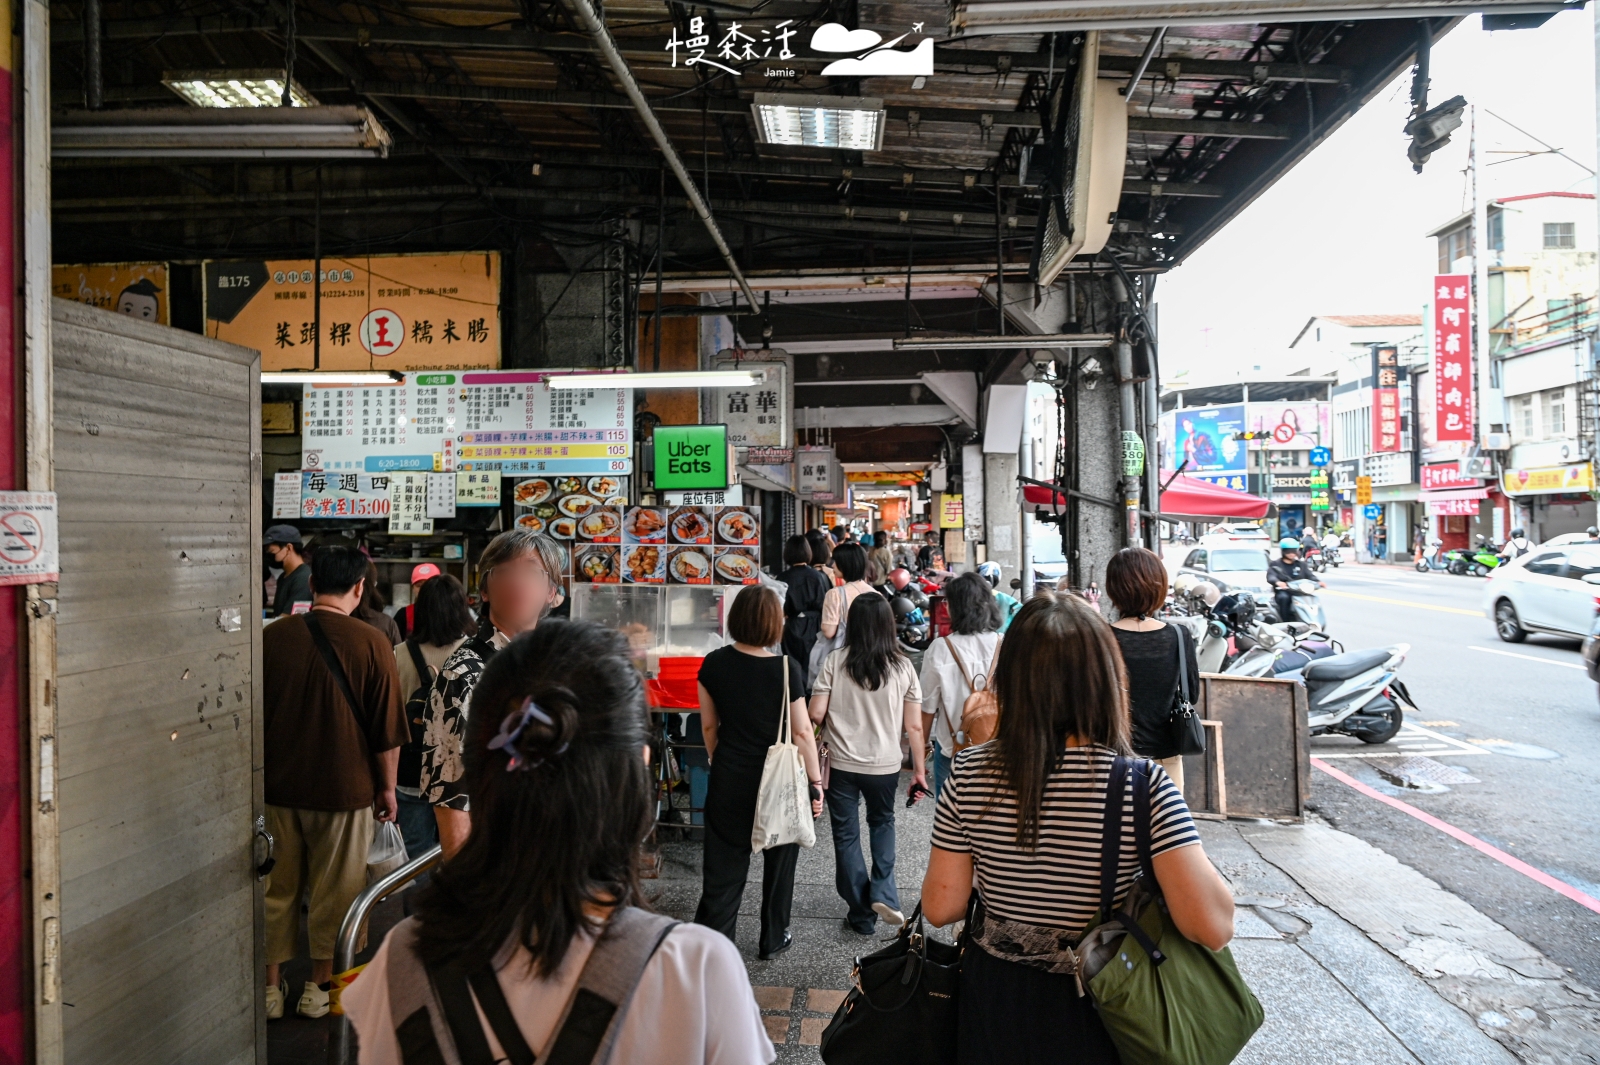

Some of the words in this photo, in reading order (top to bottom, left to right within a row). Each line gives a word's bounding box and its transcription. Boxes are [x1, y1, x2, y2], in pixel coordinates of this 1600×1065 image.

[372, 316, 394, 348] 王
[411, 317, 490, 345] 糯米腸
[405, 364, 444, 372] Taichung
[445, 363, 461, 371] 2nd
[463, 363, 491, 371] Market
[525, 385, 534, 393] 65
[526, 393, 534, 401] 80
[727, 391, 777, 413] 富華
[525, 400, 534, 408] 65
[616, 412, 625, 420] 65
[757, 415, 777, 425] 服裝
[607, 430, 625, 440] 115
[607, 446, 625, 455] 105
[668, 441, 711, 457] Uber
[1121, 451, 1144, 459] 580
[611, 461, 625, 470] 80
[668, 458, 712, 474] Eats
[802, 465, 826, 476] 富華
[308, 473, 388, 493] 每週四
[468, 474, 490, 483] 新品
[682, 492, 726, 506] 座位有限
[302, 498, 391, 516] 營業至15:00
